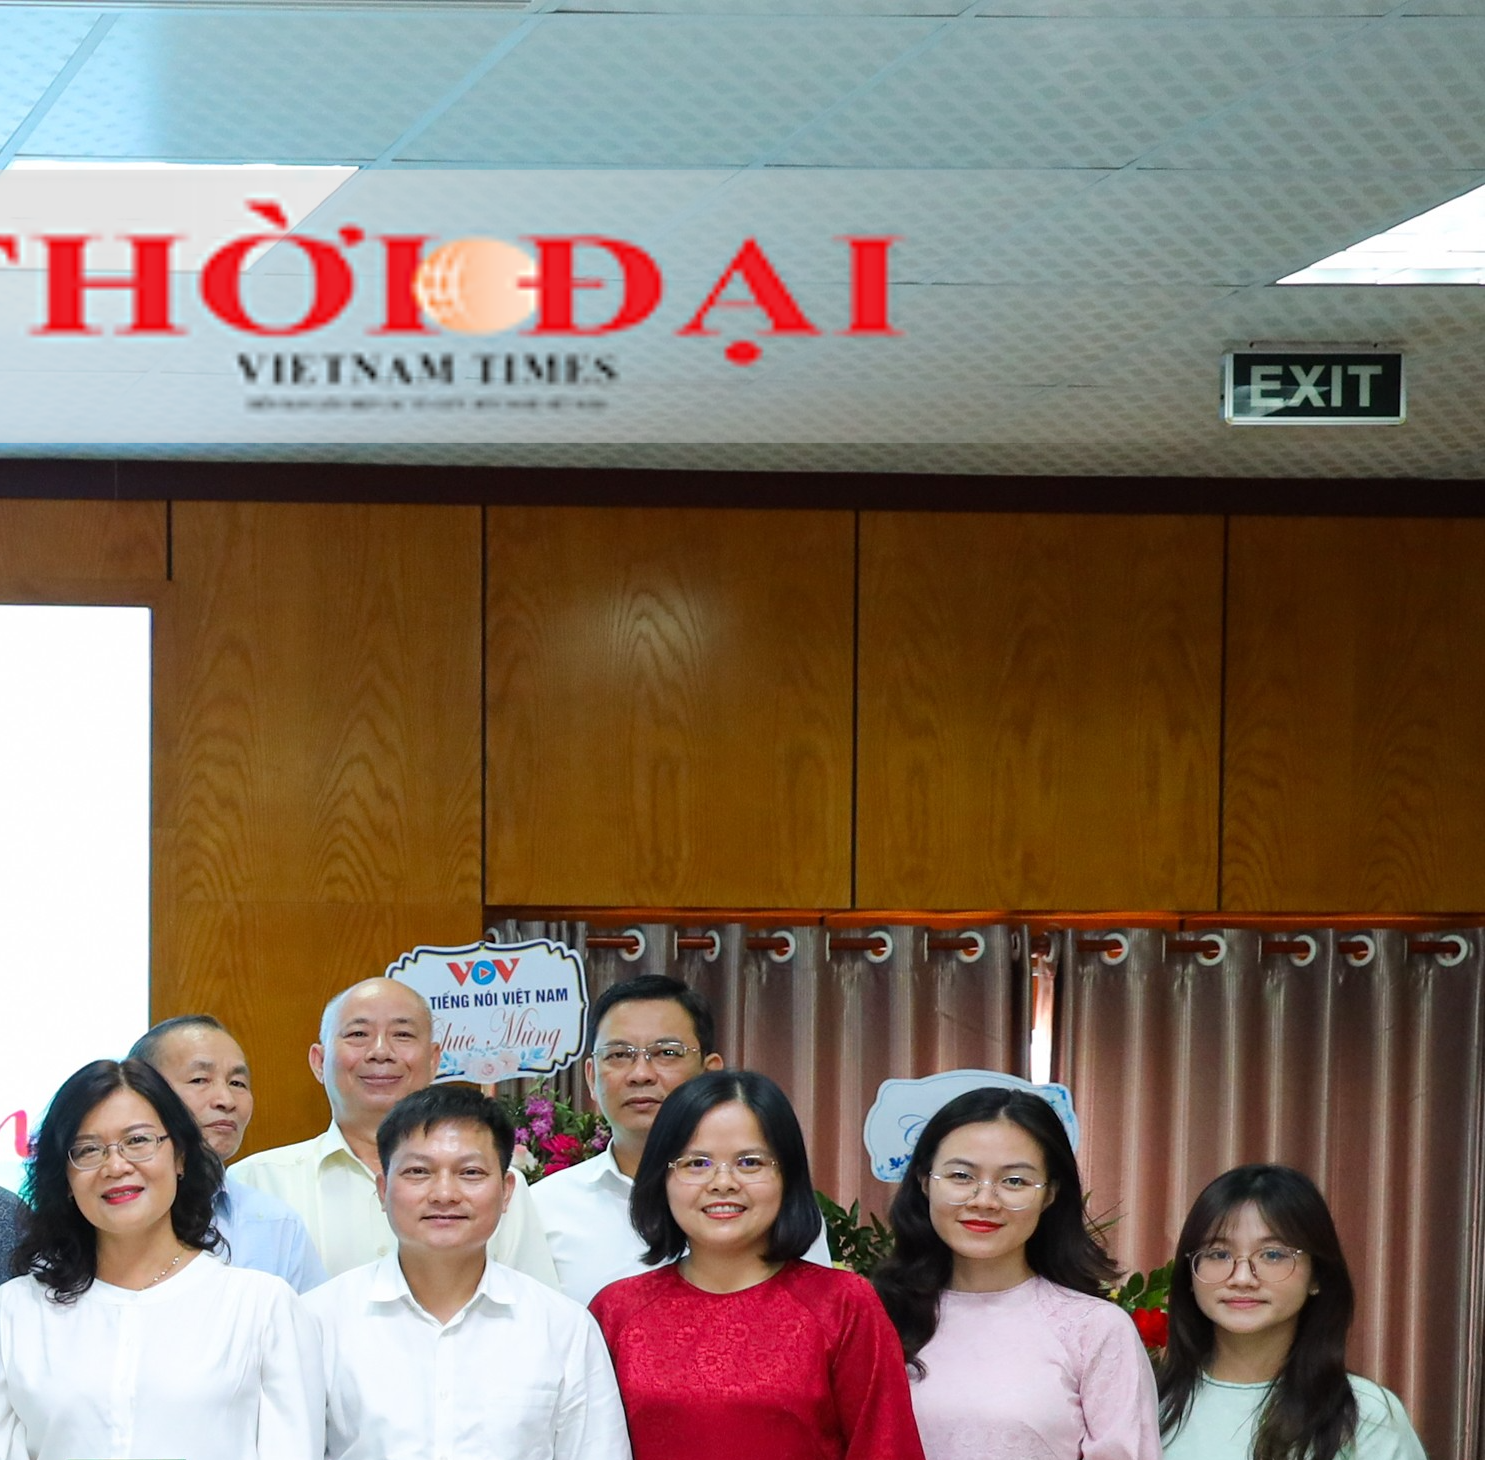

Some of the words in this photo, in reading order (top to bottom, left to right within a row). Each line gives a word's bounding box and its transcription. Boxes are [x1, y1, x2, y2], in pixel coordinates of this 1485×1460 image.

[1250, 365, 1383, 407] EXIT
[446, 957, 521, 987] VOV
[429, 989, 470, 1010] TIẾNG
[474, 989, 499, 1007] NÓI
[502, 987, 532, 1008] VIỆT
[535, 987, 569, 1003] NAM
